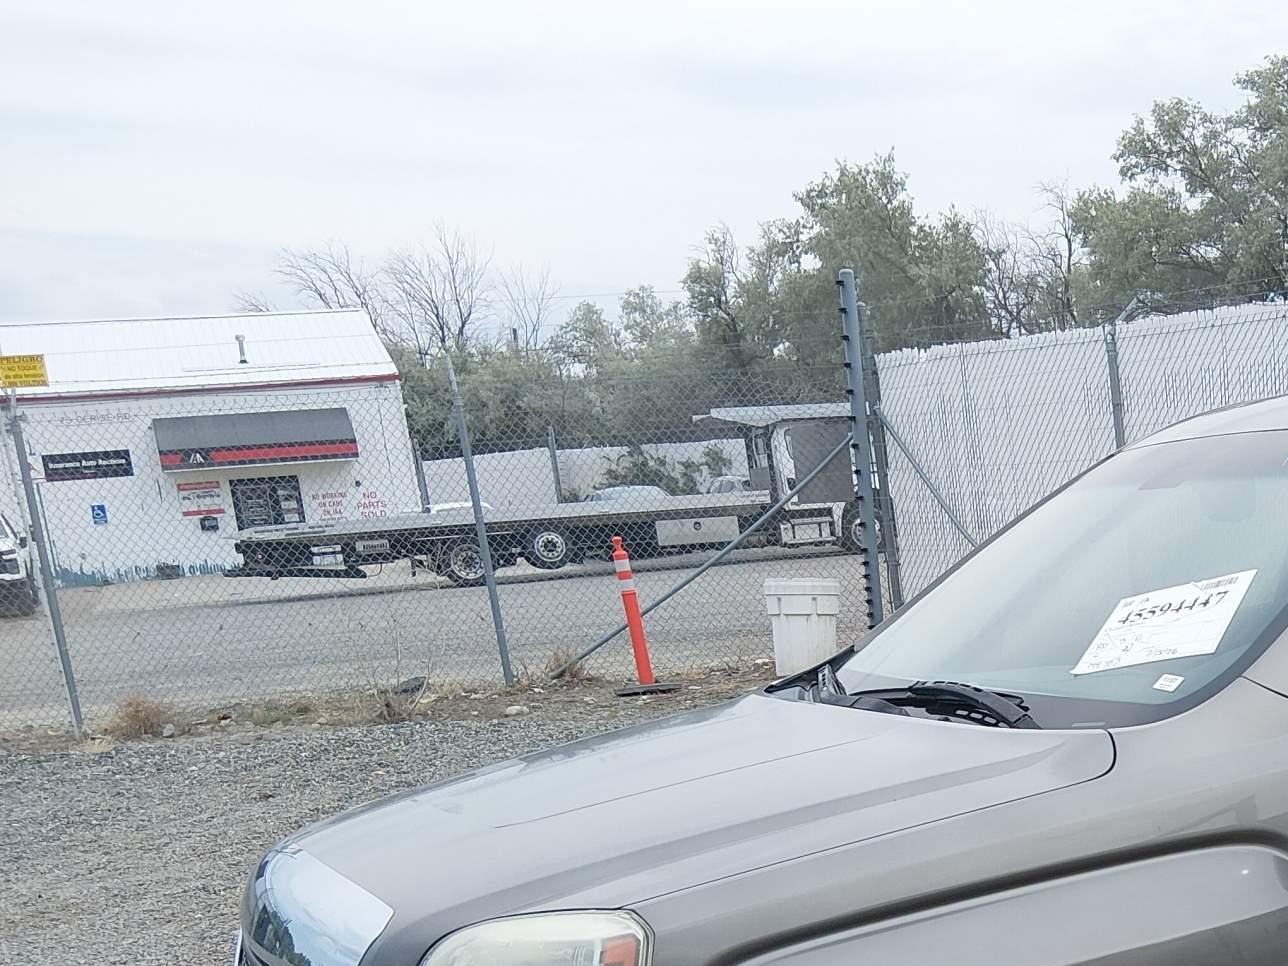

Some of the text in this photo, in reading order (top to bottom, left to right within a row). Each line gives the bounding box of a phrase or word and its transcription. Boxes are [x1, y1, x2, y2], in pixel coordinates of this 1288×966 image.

[362, 491, 377, 499] NO
[357, 500, 387, 510] PARTS
[361, 509, 387, 519] SOLD
[1117, 590, 1230, 624] 45594447
